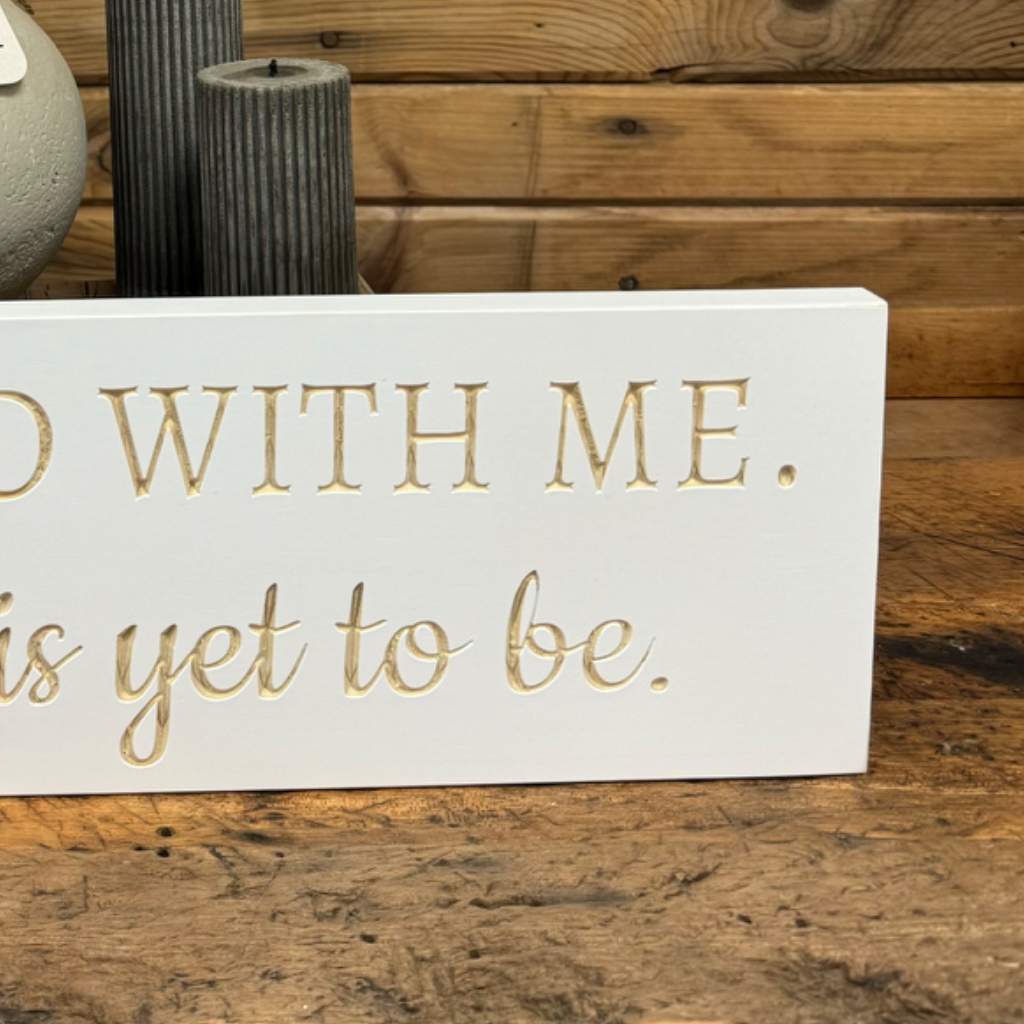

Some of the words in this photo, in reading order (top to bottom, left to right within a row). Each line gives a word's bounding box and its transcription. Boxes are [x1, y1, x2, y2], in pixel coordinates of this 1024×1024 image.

[99, 383, 490, 498] WITH
[545, 378, 796, 490] ME.
[114, 582, 308, 767] yet
[336, 581, 474, 697] to
[505, 570, 668, 693] be.
